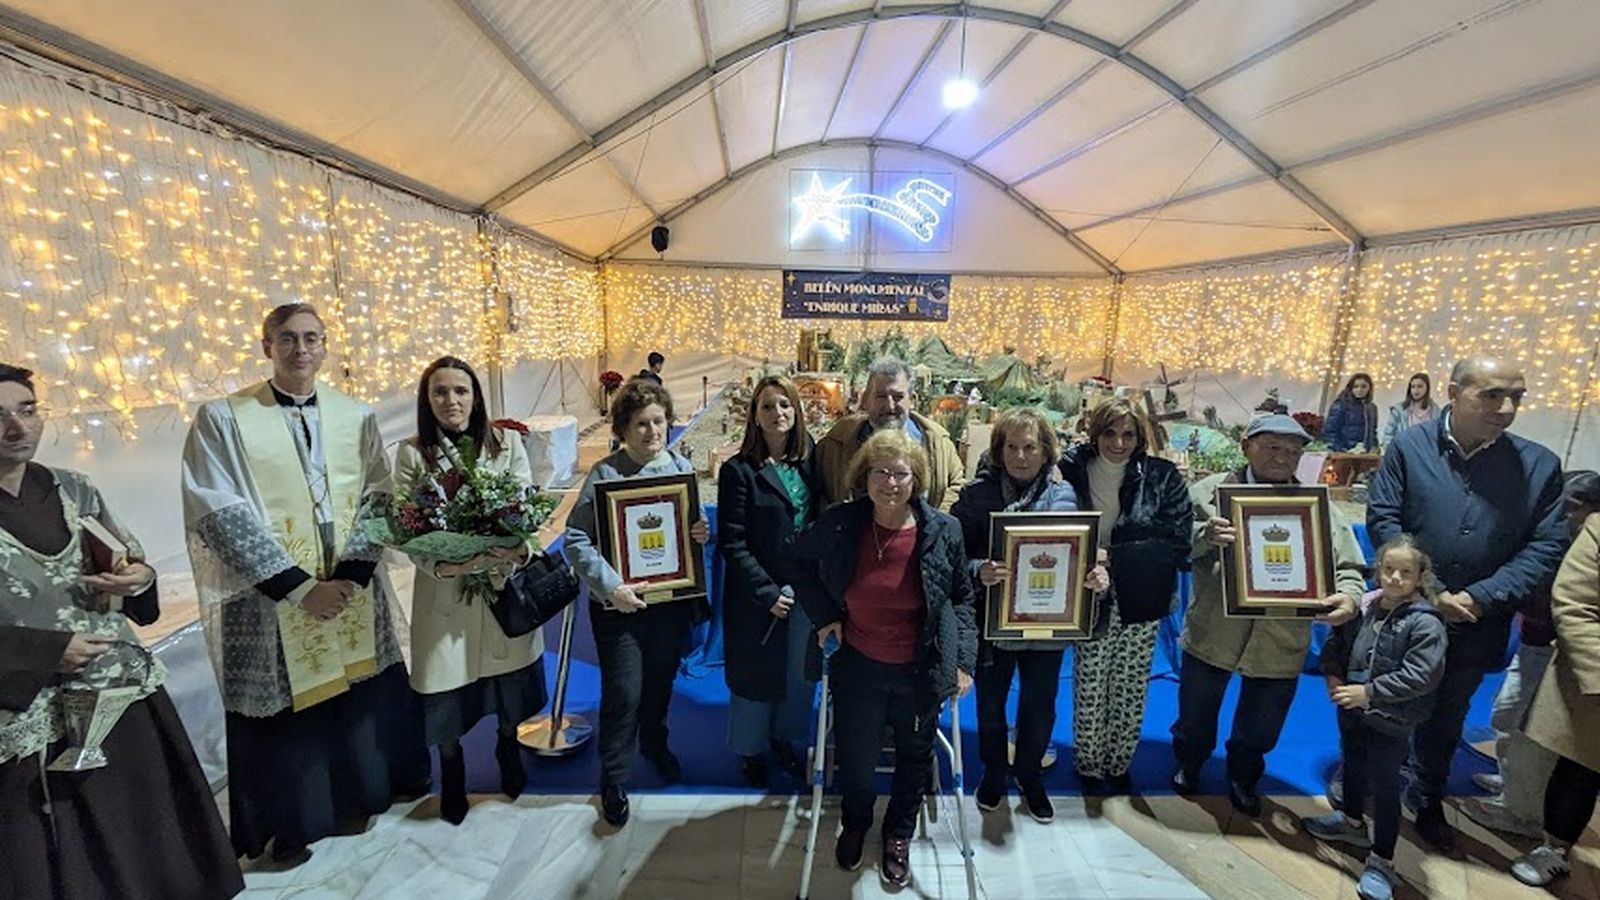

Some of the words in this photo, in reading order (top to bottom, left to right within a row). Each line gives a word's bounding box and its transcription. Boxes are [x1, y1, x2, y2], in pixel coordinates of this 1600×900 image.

[804, 281, 842, 294] BELÉN
[843, 284, 925, 296] MONUMENTAL
[804, 301, 859, 313] "ENRIQUE
[862, 303, 905, 314] MIRAS"
